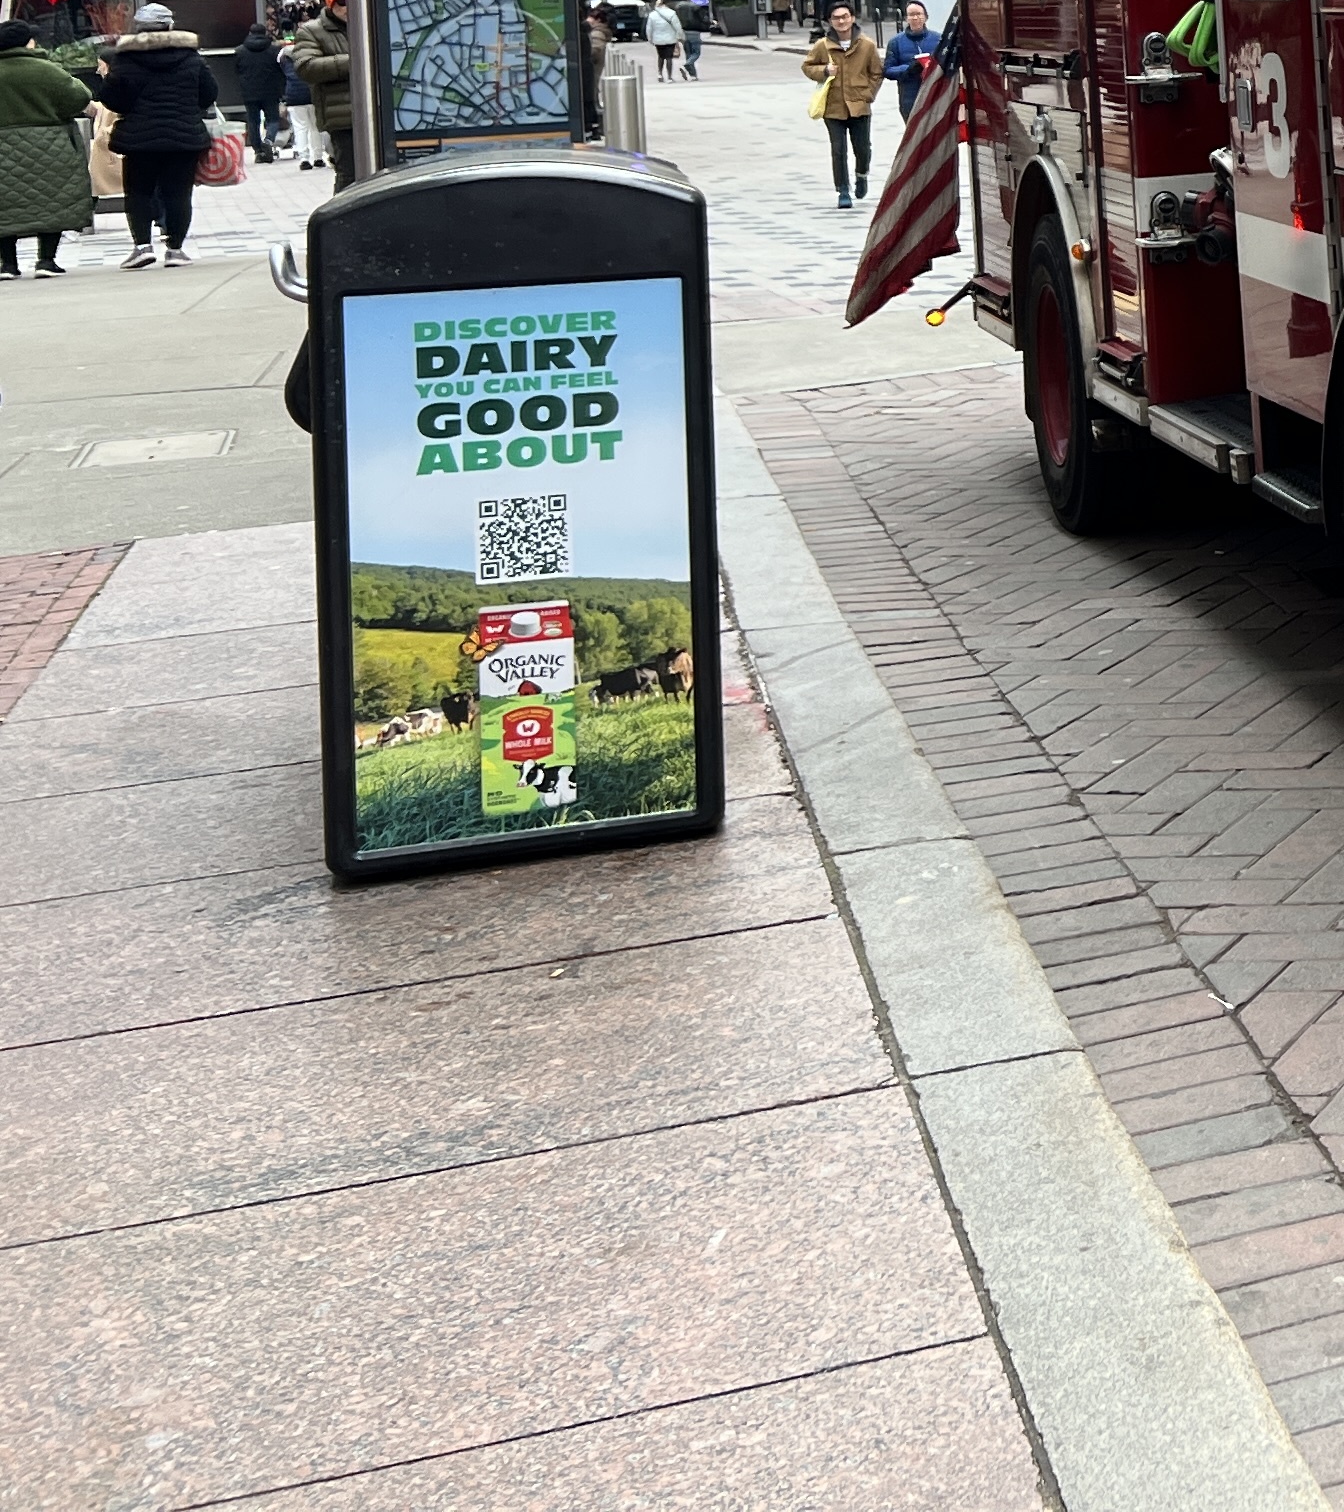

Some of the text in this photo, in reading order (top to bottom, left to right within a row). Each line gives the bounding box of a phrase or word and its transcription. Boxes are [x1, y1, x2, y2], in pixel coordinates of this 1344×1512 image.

[1255, 51, 1291, 179] 3
[414, 310, 618, 342] DISCOVER
[415, 333, 618, 379] DAIRY
[414, 371, 619, 399] YOU CAN FEEL
[416, 391, 619, 439] GOOD
[416, 429, 623, 476] ABOUT
[488, 653, 566, 674] ORGANIC
[495, 666, 561, 684] VALLEY
